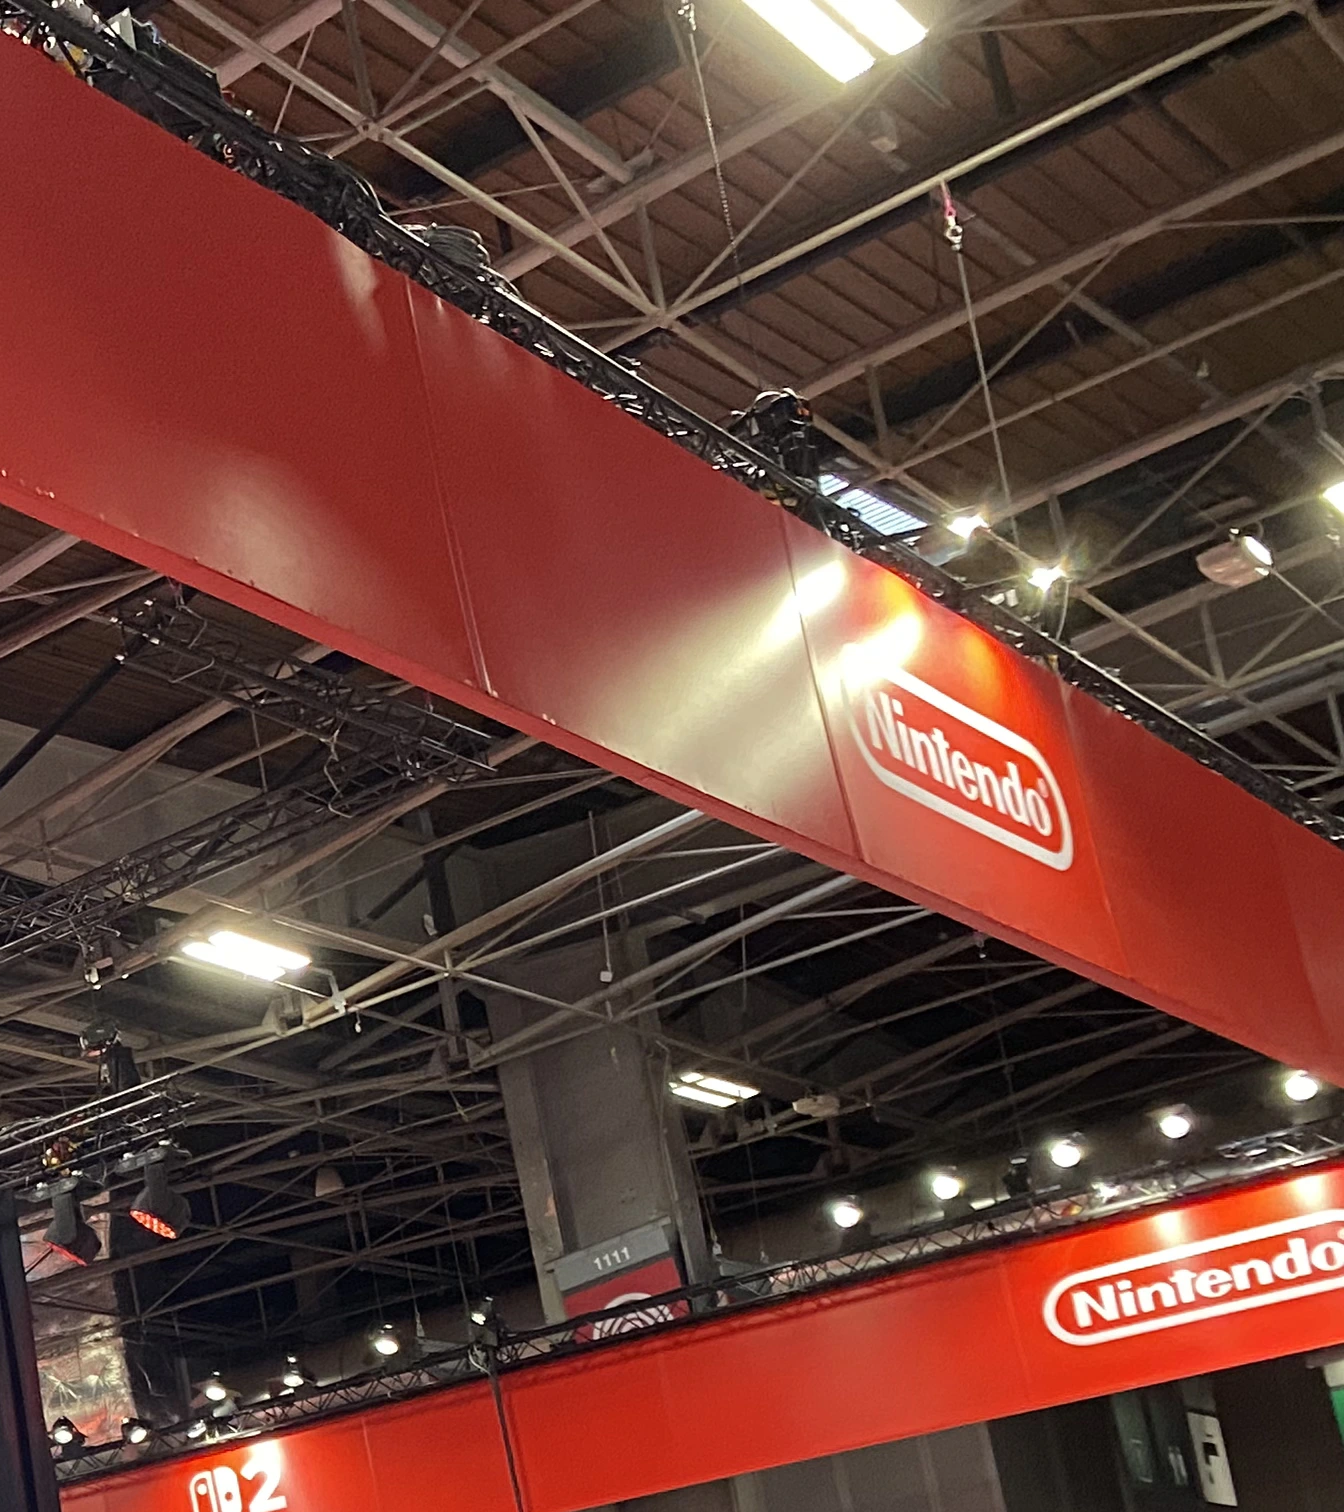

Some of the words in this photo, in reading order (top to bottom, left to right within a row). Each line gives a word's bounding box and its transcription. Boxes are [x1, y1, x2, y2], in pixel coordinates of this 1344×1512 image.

[865, 690, 1054, 838] Nintendo
[593, 1246, 631, 1271] 1111
[1070, 1237, 1344, 1329] Nintendo
